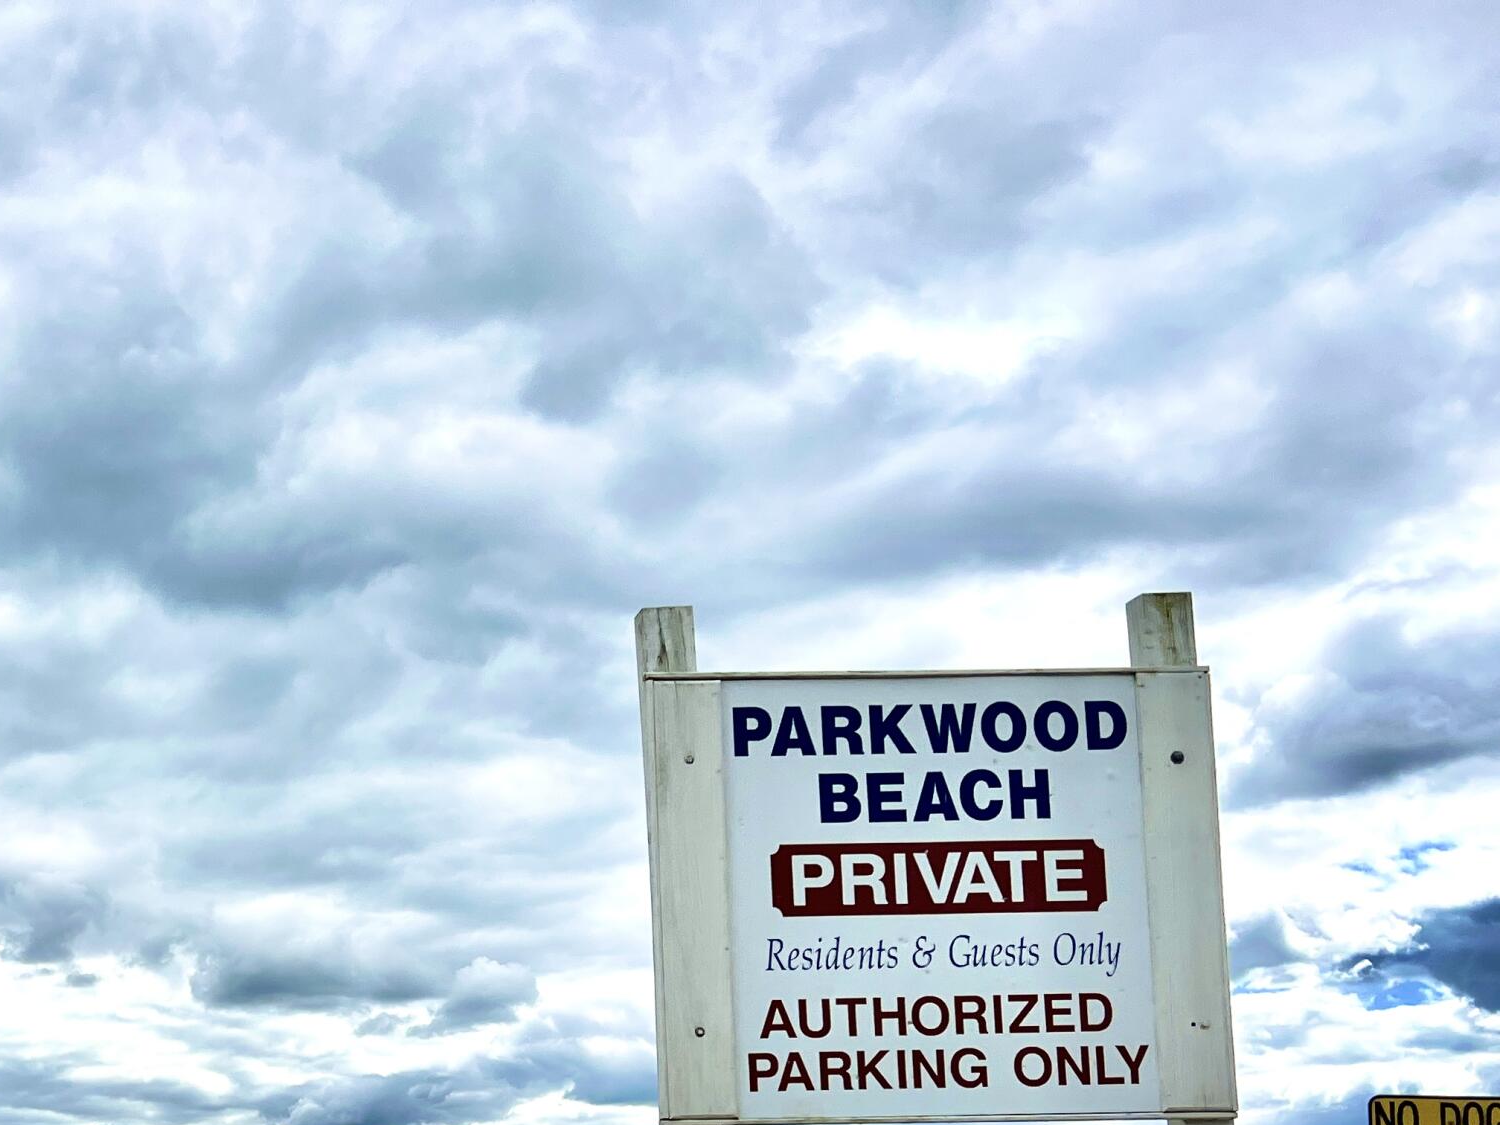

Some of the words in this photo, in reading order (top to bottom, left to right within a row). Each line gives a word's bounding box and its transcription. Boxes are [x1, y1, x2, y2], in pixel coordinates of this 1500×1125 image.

[732, 700, 1128, 757] PARKWOOD
[818, 768, 1052, 824] BEACH
[791, 848, 1089, 907] PRIVATE
[765, 936, 898, 971] Residents
[912, 936, 936, 968] &
[948, 934, 1040, 968] Guests
[1053, 932, 1122, 977] Only
[760, 992, 1114, 1039] AUTHORIZED
[747, 1048, 989, 1092] PARKING
[1014, 1044, 1150, 1086] ONLY
